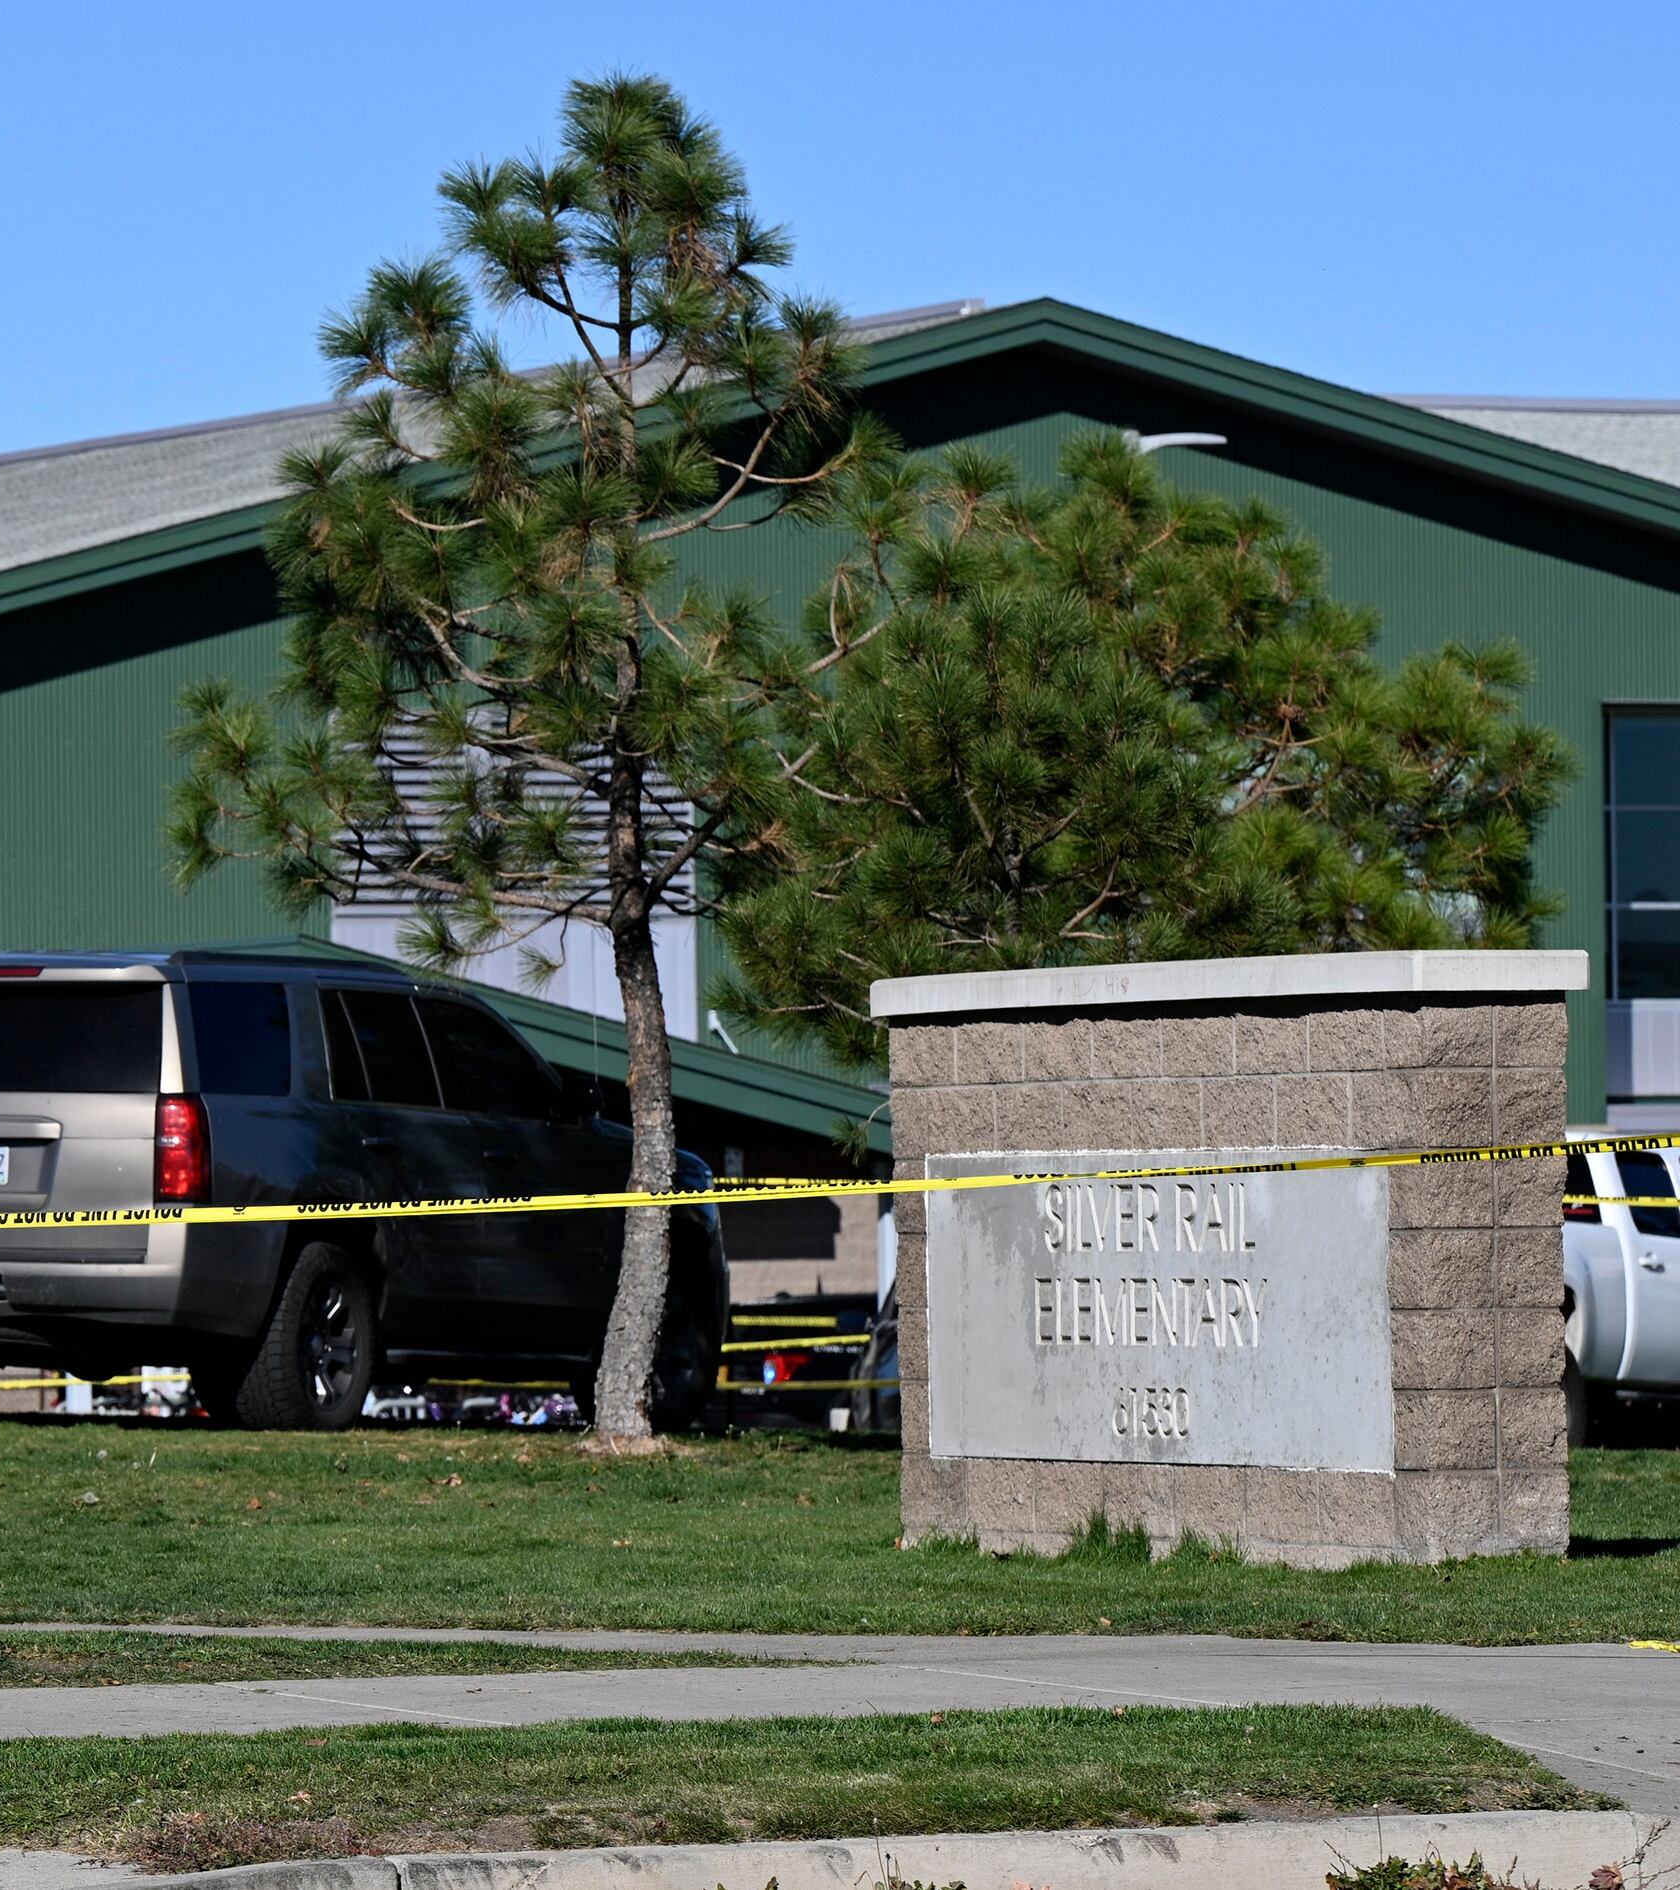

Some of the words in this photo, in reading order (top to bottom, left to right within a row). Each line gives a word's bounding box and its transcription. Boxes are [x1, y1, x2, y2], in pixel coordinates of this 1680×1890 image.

[1044, 1183, 1160, 1253] SILVER
[1175, 1182, 1256, 1252] RAIL
[1034, 1277, 1268, 1347] ELEMENTARY
[1111, 1386, 1190, 1439] 61530
